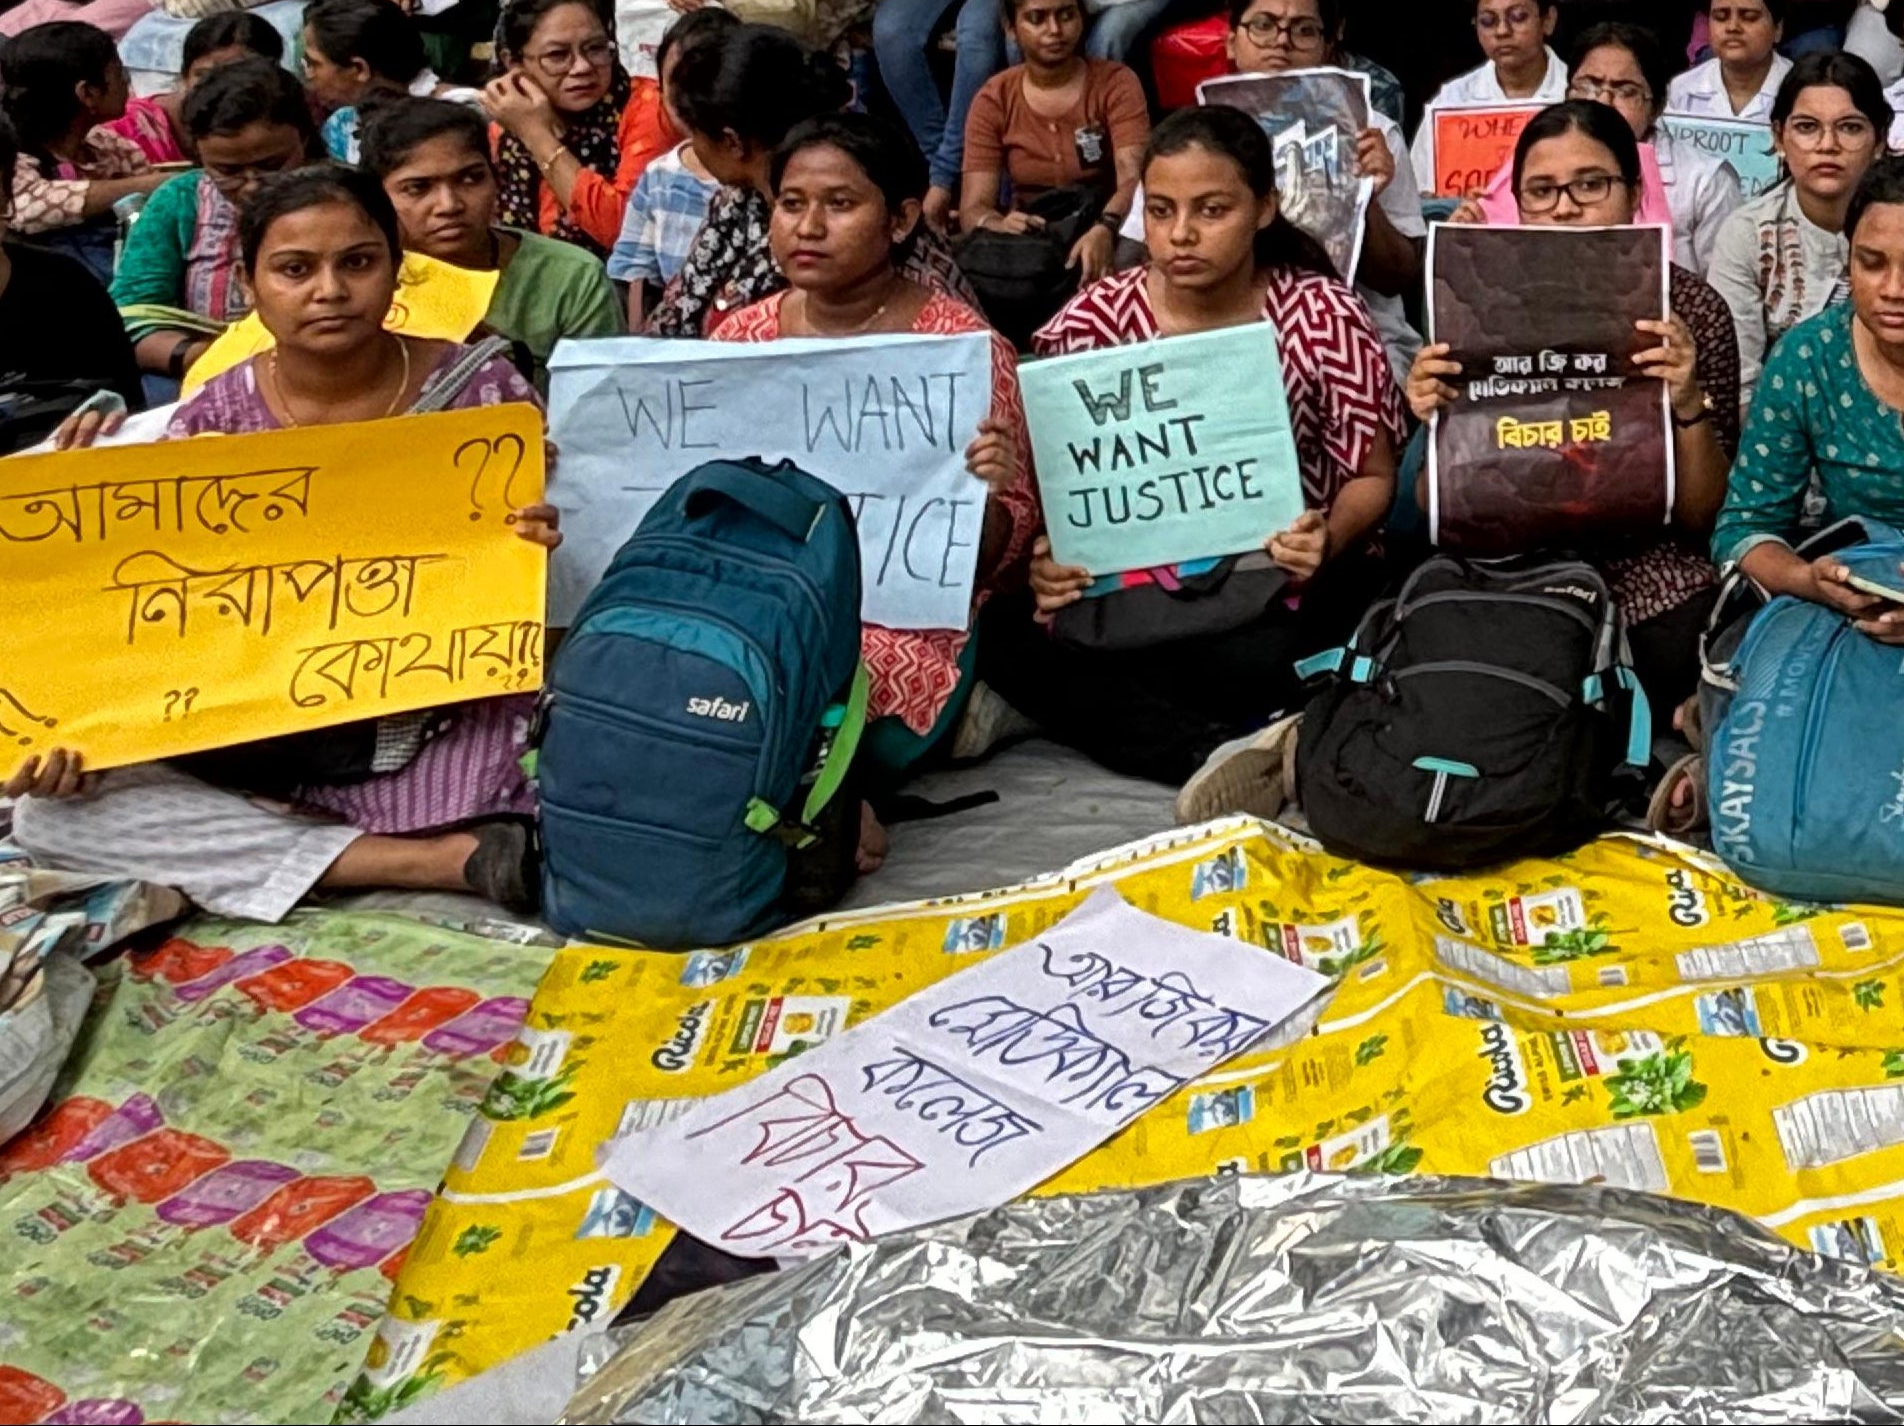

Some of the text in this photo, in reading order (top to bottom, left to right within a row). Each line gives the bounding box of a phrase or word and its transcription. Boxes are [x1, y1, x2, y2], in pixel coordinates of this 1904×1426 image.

[1493, 349, 1608, 376] আর জি কর
[617, 371, 968, 454] WE WANT
[1072, 362, 1179, 426] WE
[1067, 414, 1206, 476] WANT
[1496, 409, 1613, 450] বিচার চাই
[1067, 458, 1265, 529] JUSTICE
[686, 695, 751, 724] safari
